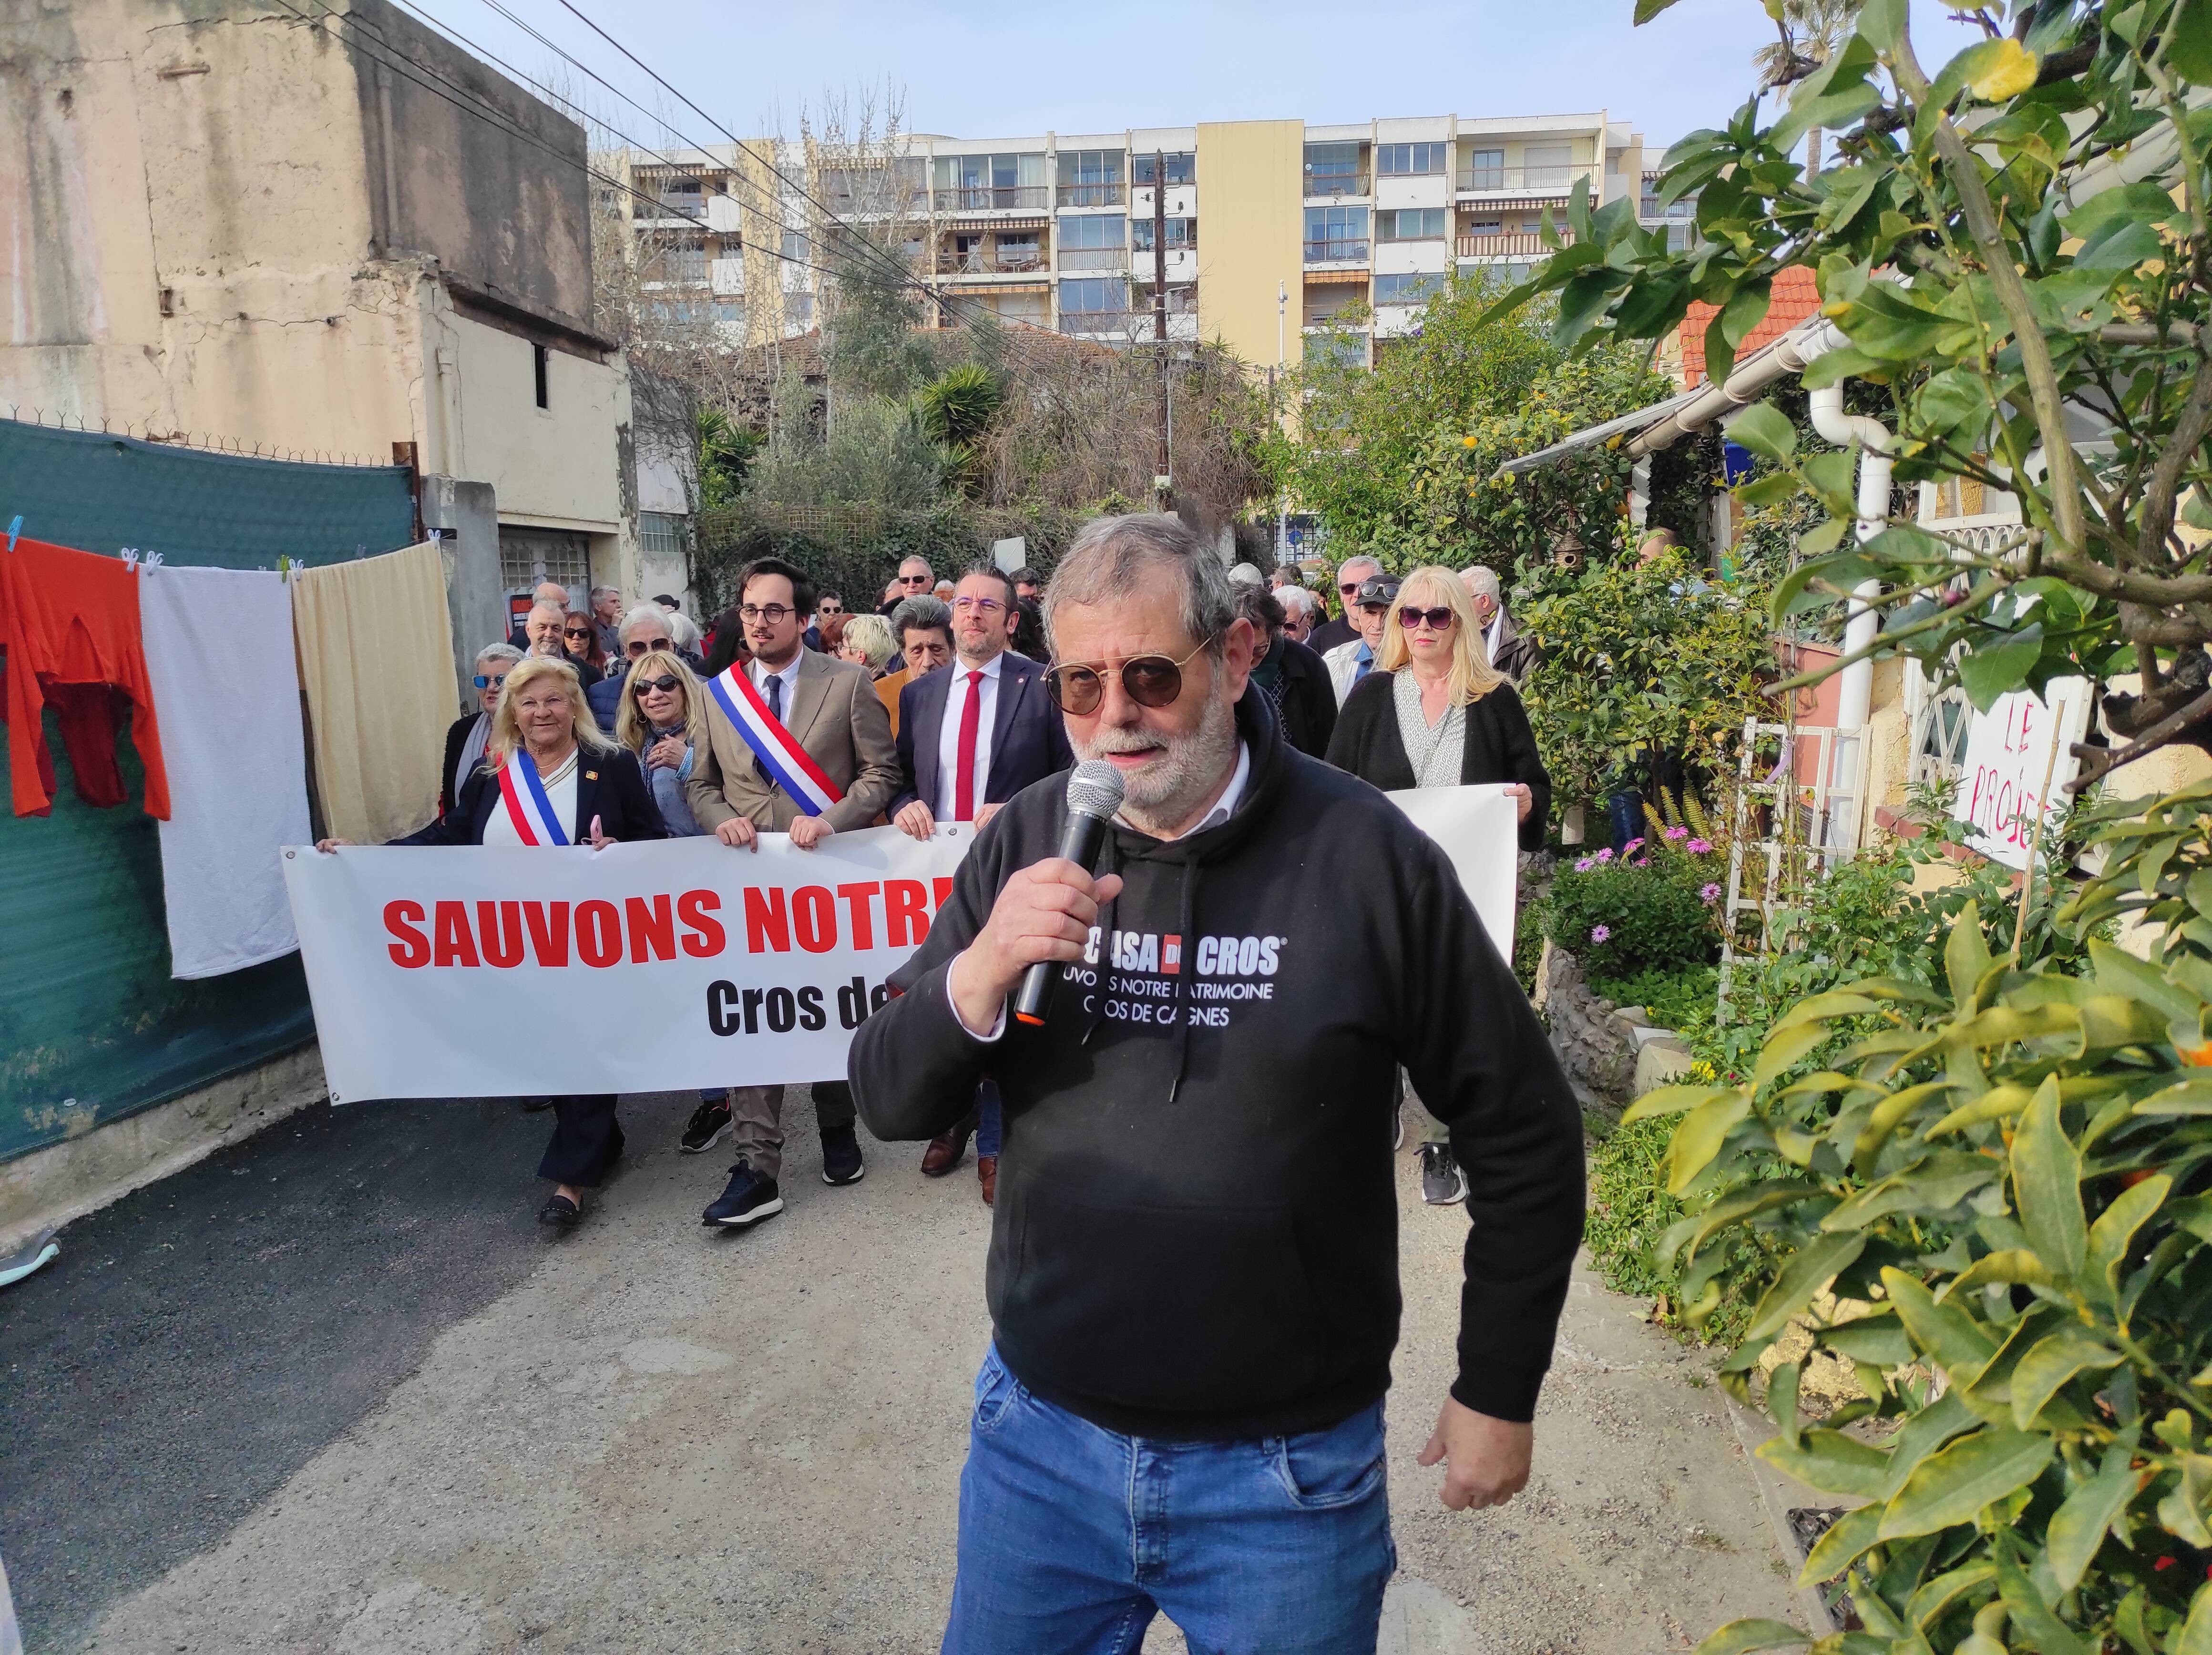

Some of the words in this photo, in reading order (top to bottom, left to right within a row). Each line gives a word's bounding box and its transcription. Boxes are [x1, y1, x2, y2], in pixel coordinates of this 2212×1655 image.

[2004, 694, 2034, 755] LE
[383, 889, 726, 968] SAUVONS
[707, 979, 826, 1036] Cros
[1083, 995, 1128, 1020] COS
[1132, 1002, 1153, 1023] DE
[1121, 978, 1171, 998] NOTRE
